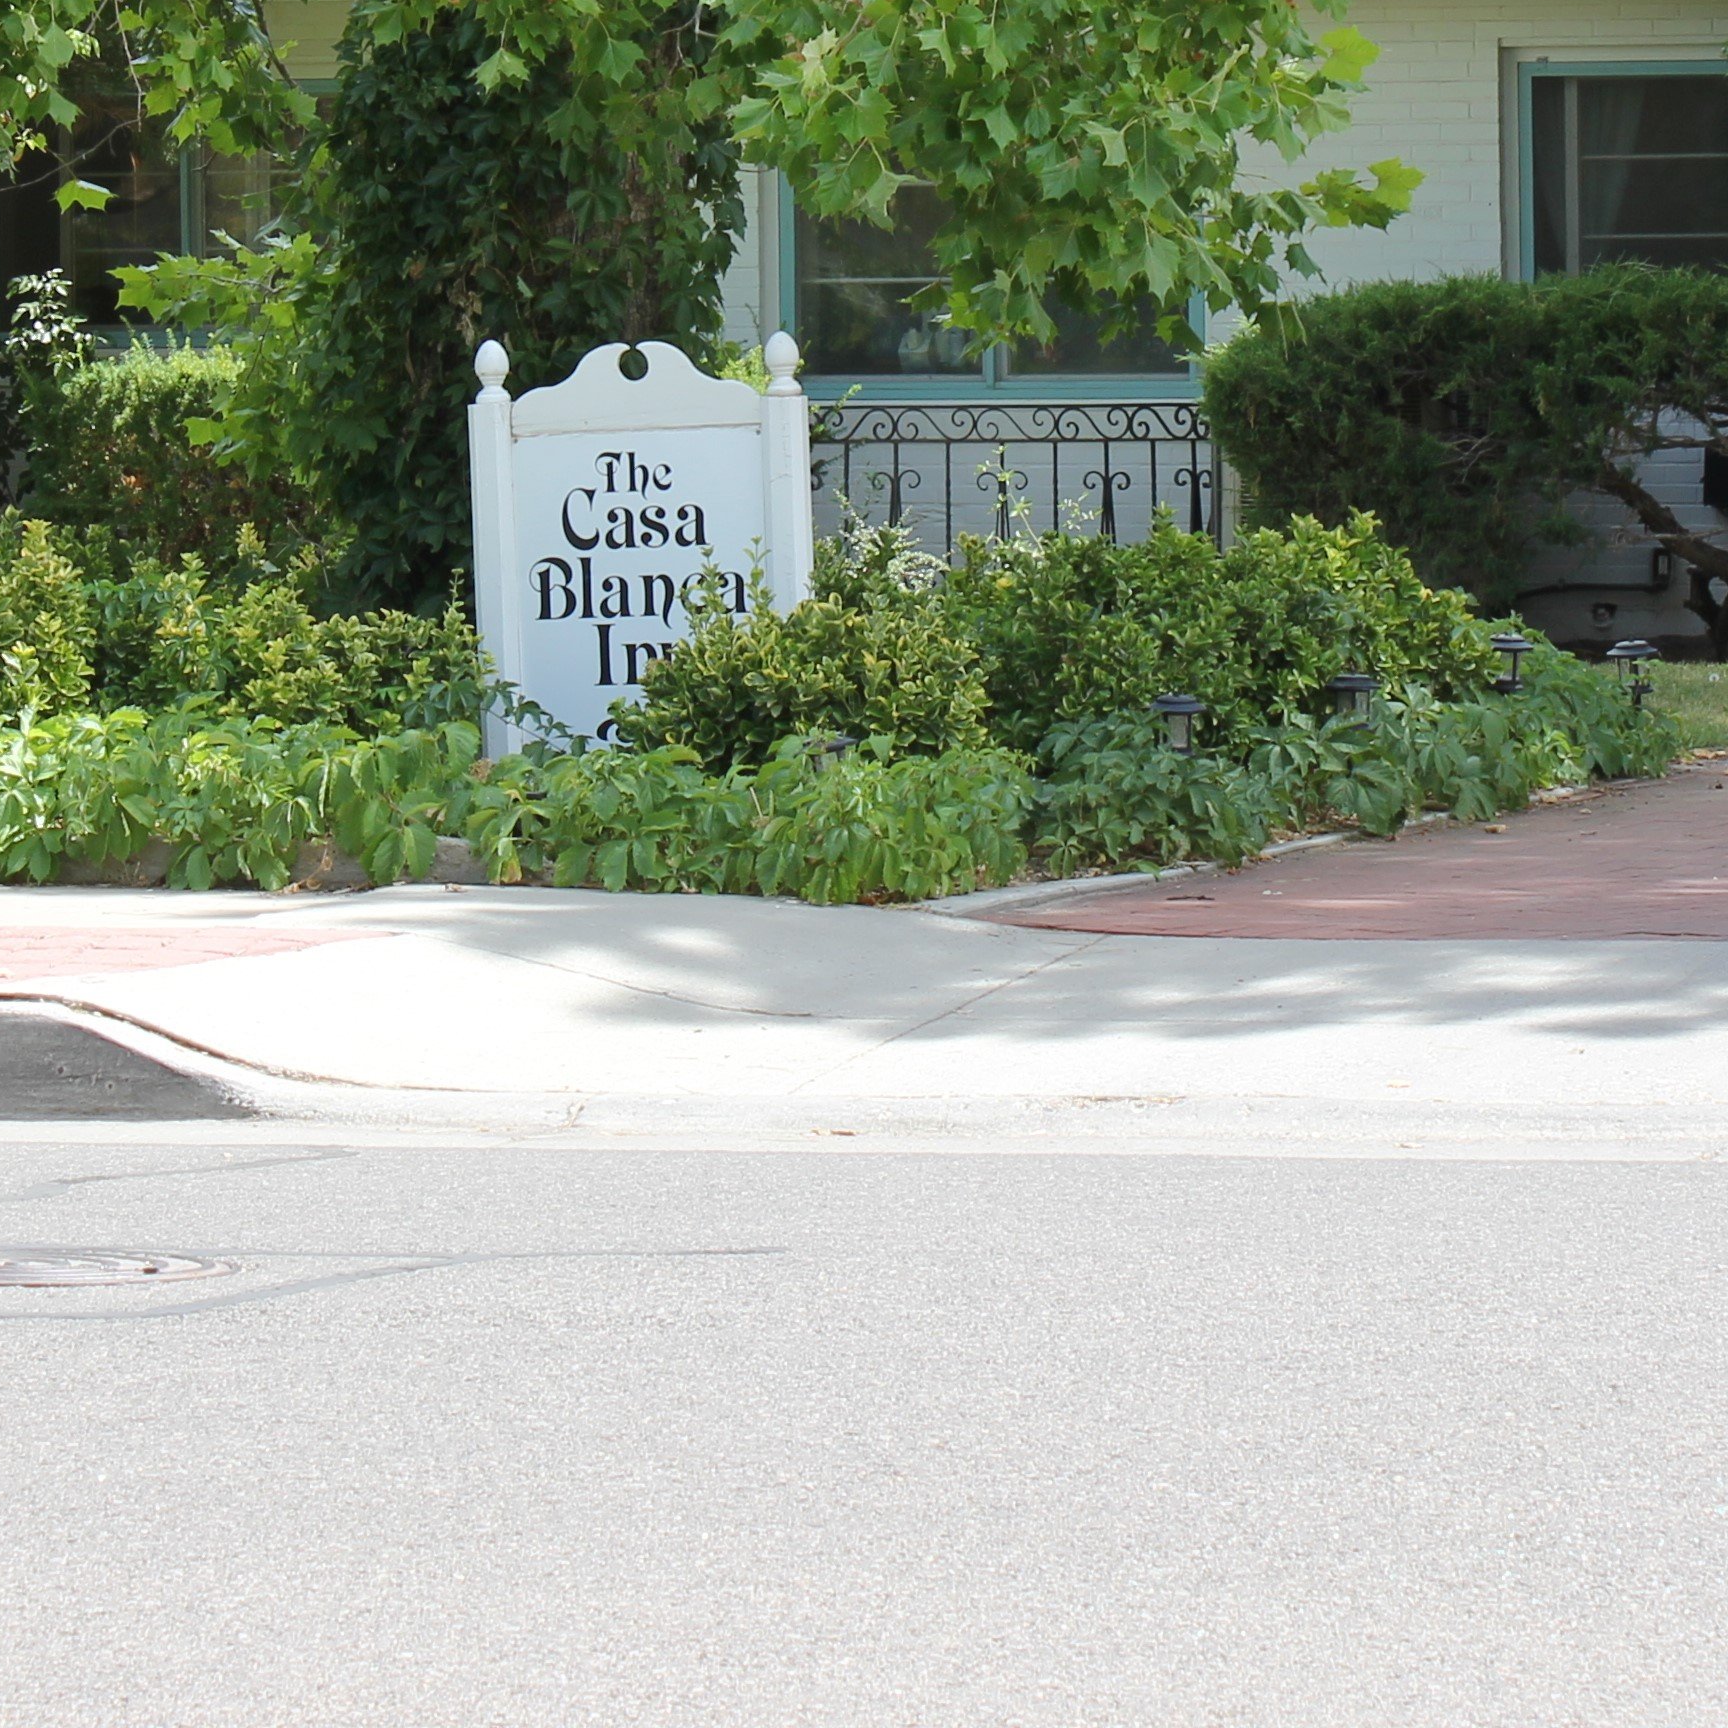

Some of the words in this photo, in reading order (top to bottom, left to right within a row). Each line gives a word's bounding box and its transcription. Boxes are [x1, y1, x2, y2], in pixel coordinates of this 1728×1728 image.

[594, 451, 673, 499] The
[561, 487, 708, 551] Casa
[529, 556, 751, 629] Blanca
[592, 623, 674, 686] In
